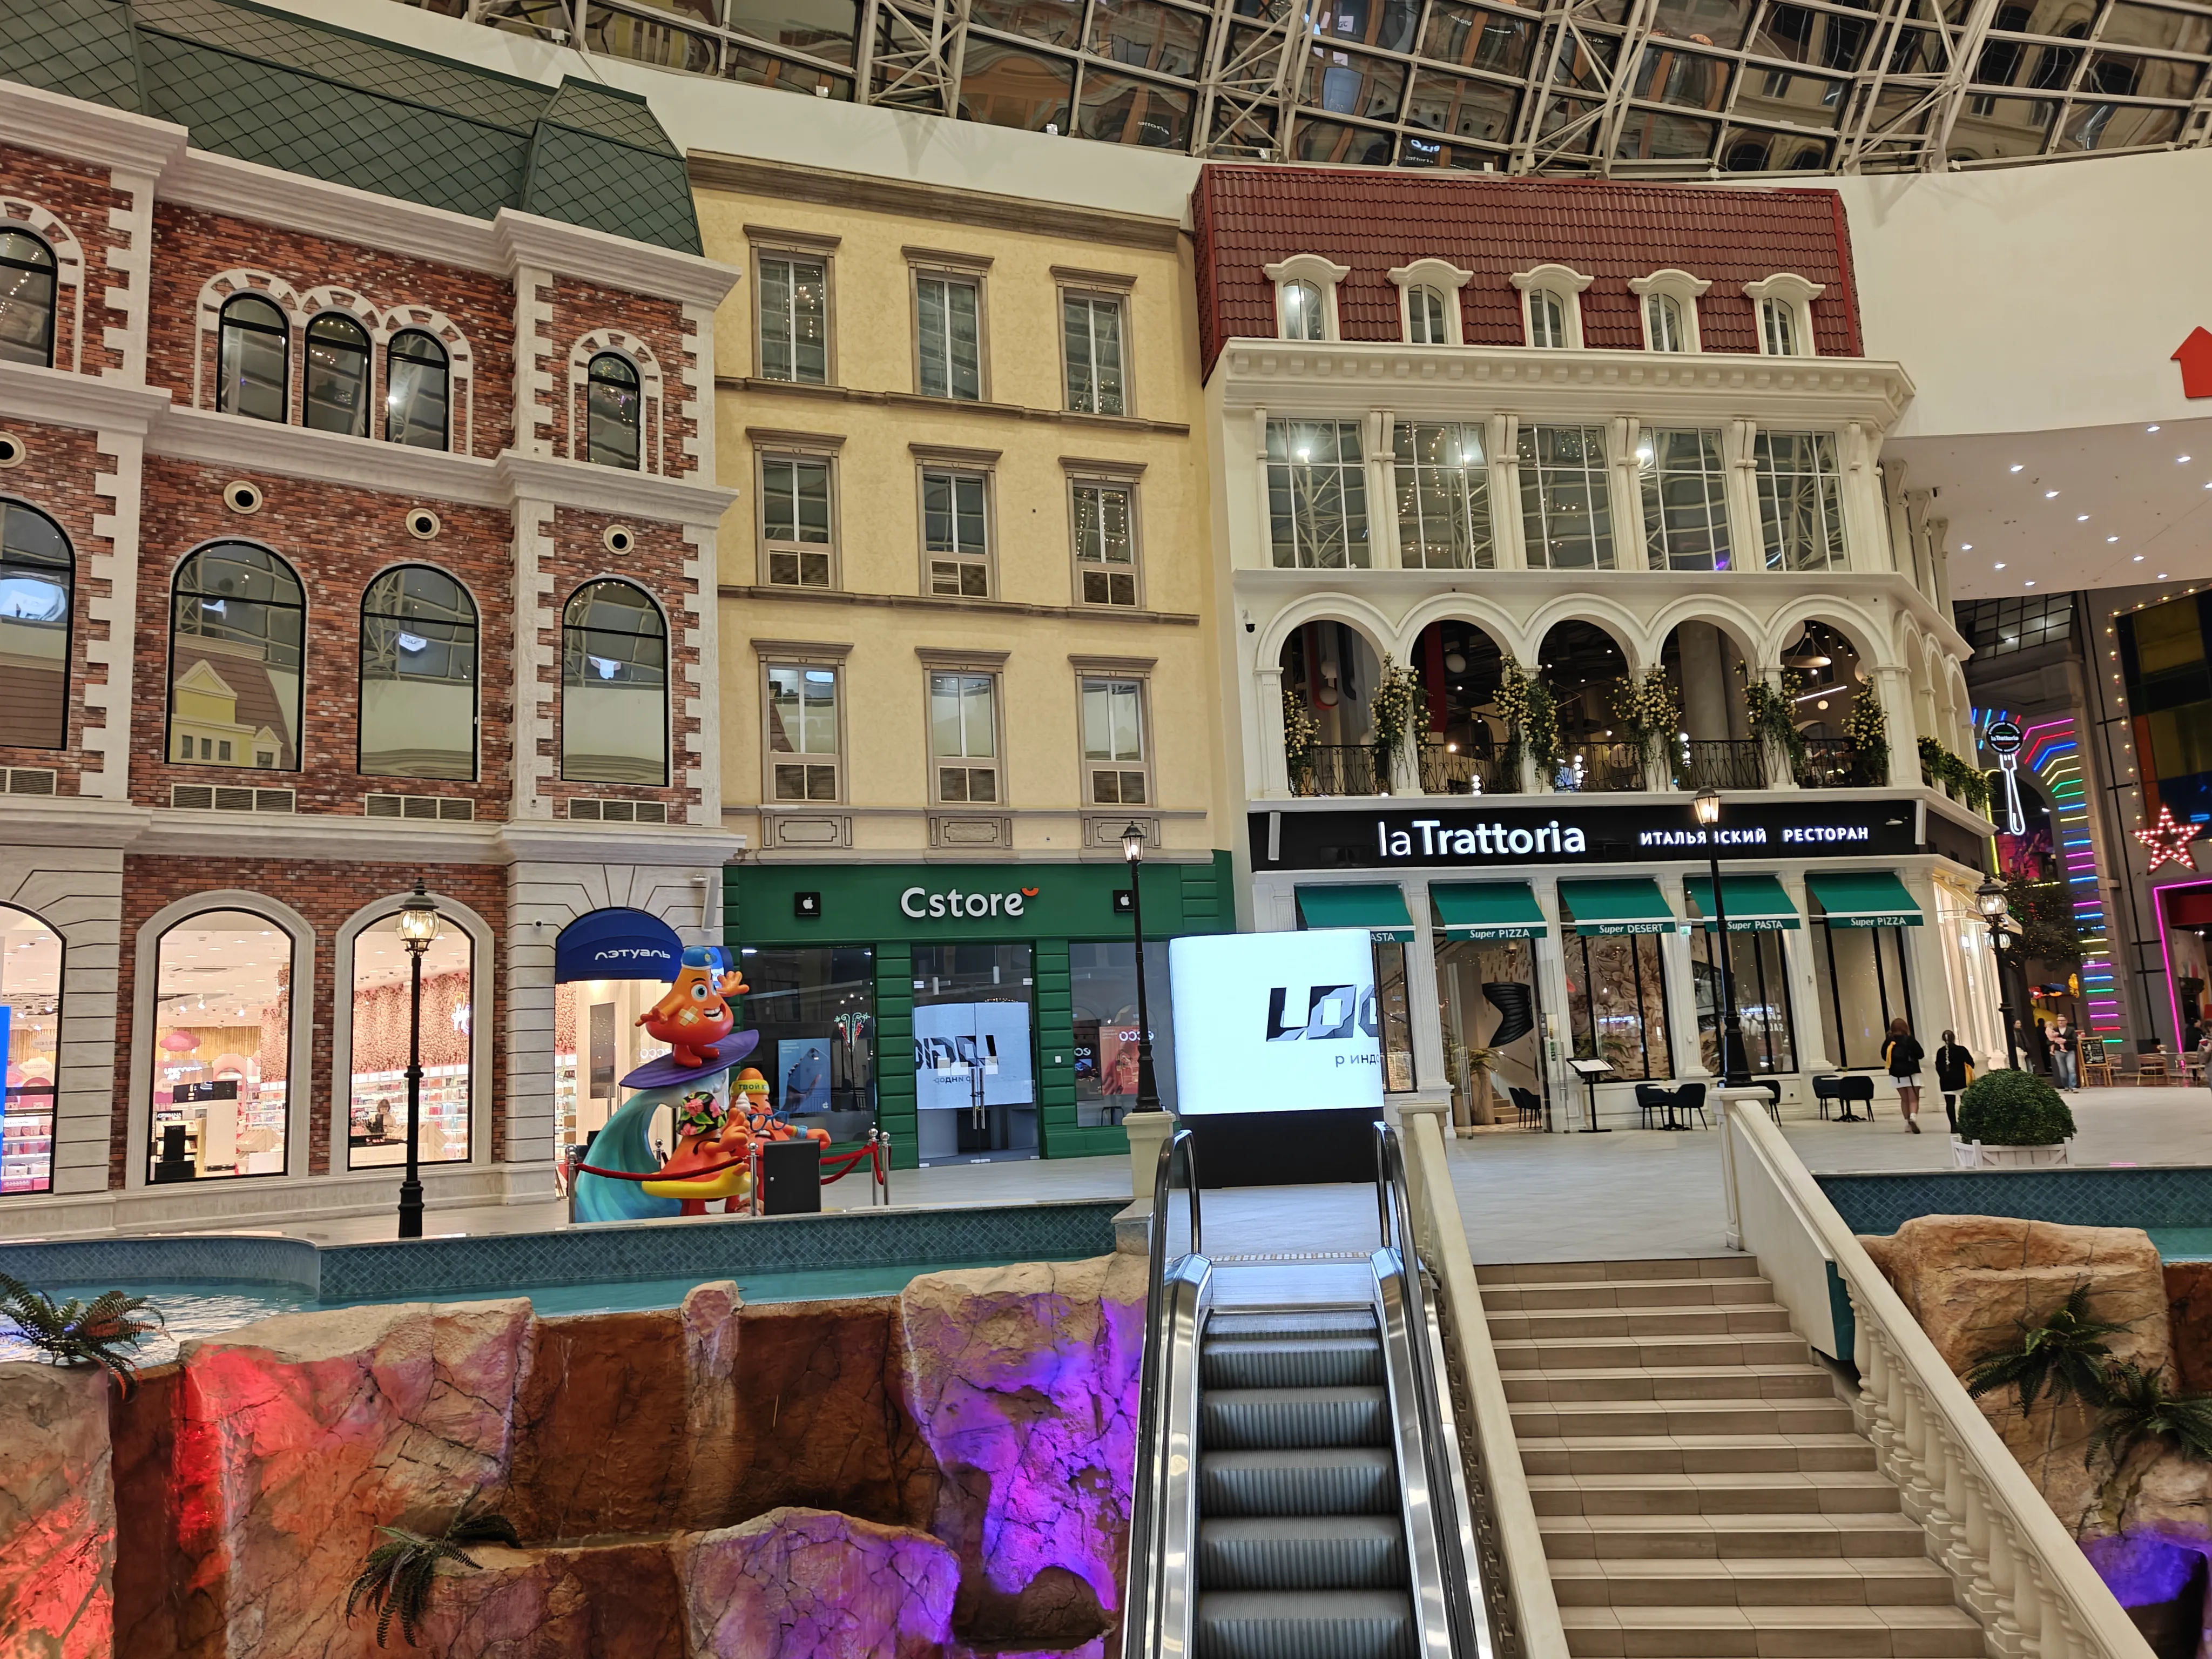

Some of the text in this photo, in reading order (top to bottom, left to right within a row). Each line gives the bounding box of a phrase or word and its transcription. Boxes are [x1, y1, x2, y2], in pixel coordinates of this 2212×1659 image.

[1784, 827, 1869, 842] РЕСТОРАН
[900, 887, 1024, 918] Cstore
[1728, 920, 1784, 930] Super PASTA
[1851, 917, 1907, 927] Super PIZZA
[1469, 928, 1530, 940] Super PIZZA
[1599, 923, 1663, 934] Super DESERT
[1371, 932, 1395, 942] ASTA
[595, 949, 671, 960] ЛЭТУАЛЬ
